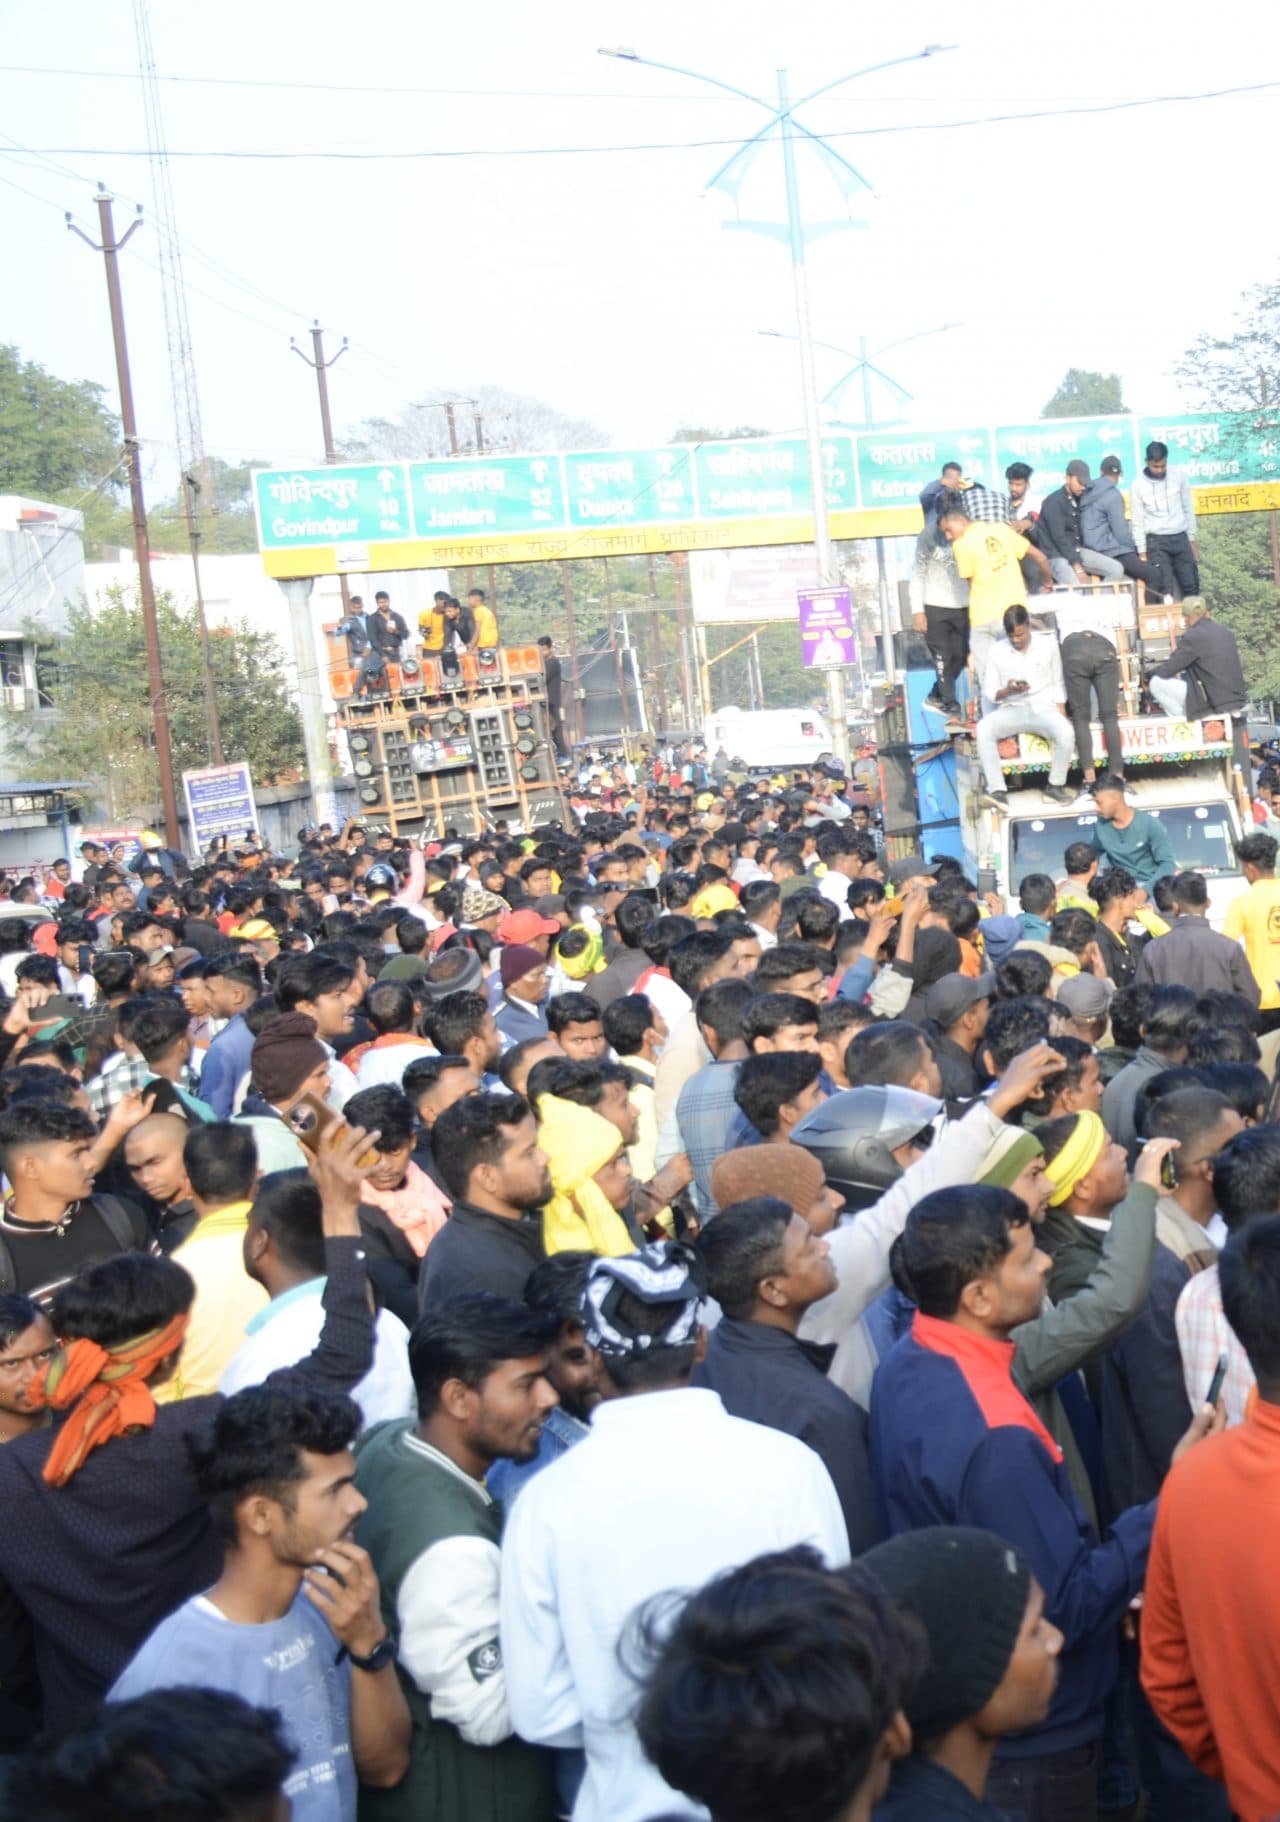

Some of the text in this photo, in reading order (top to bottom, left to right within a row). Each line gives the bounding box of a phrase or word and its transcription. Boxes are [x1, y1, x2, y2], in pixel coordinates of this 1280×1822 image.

[869, 441, 938, 465] कतरास
[268, 474, 358, 509] गोविन्दपुर
[380, 497, 400, 517] 10
[271, 516, 360, 539] Govindpur
